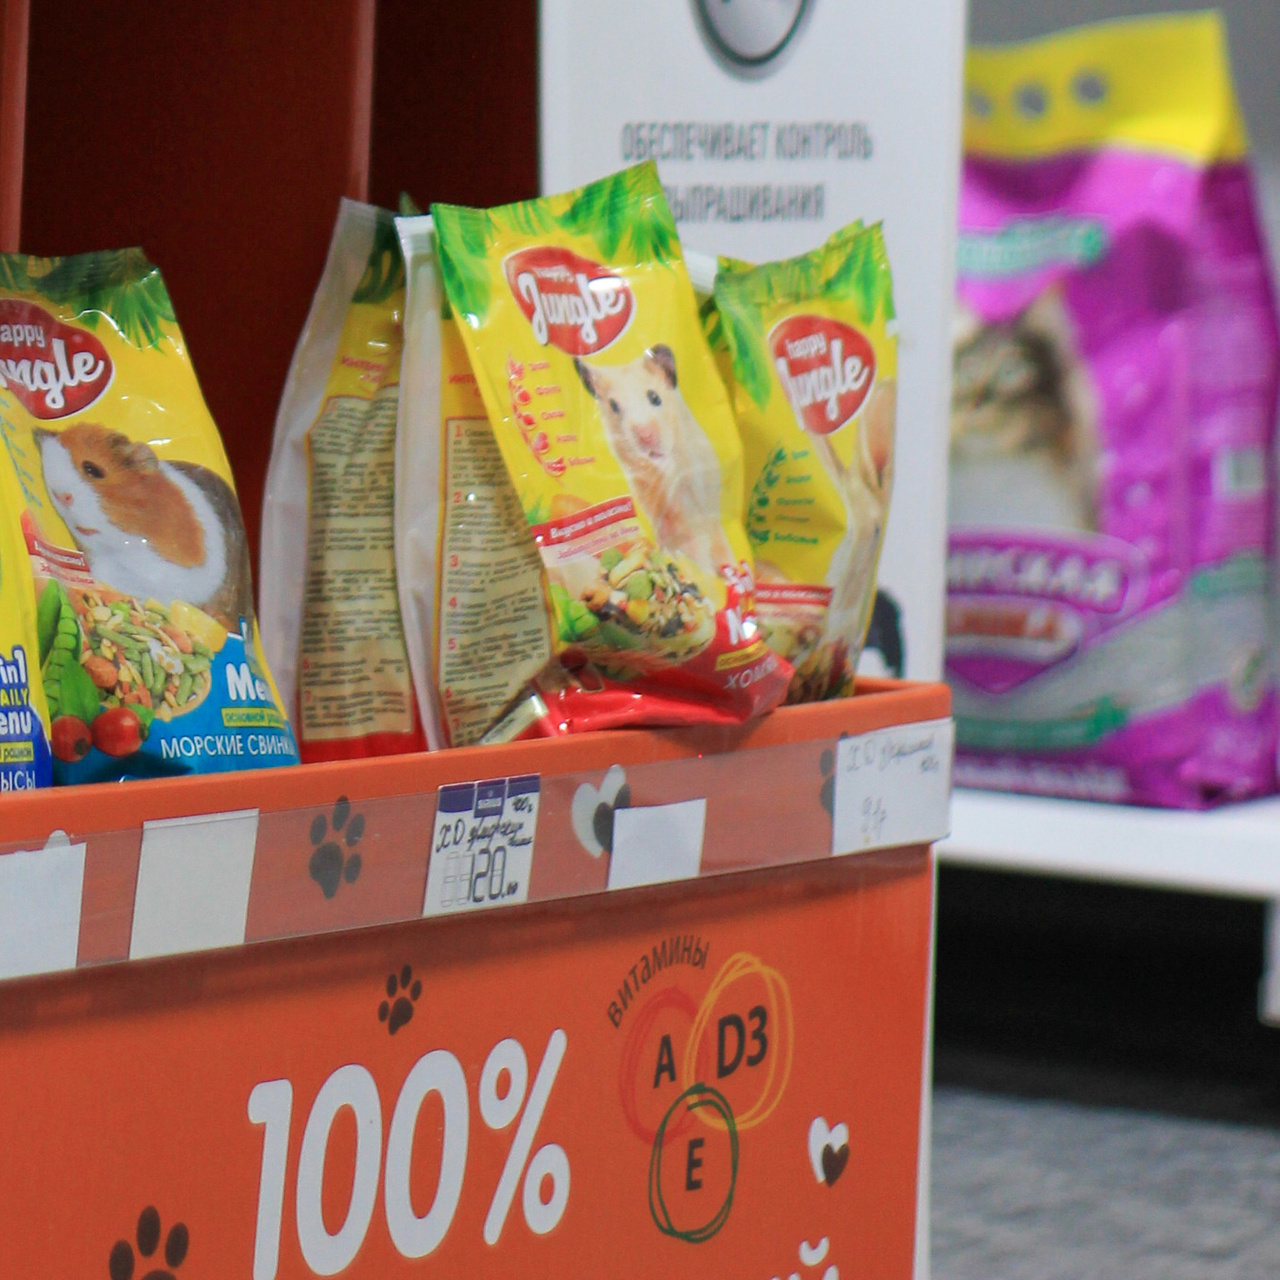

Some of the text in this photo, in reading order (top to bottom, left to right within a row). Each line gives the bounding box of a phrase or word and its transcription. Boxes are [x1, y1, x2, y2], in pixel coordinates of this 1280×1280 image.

[621, 121, 874, 162] ОБЕСПЕЧИВАЕТ КОНТРОЛЬ
[517, 269, 625, 346] Jungle
[784, 331, 827, 360] happy
[775, 338, 870, 431] Jungle
[3, 745, 34, 763] рацион
[160, 734, 244, 760] МОРСКИЕ
[652, 1033, 677, 1089] A
[717, 1004, 769, 1080] D3
[247, 1027, 571, 1280] 100%
[685, 1136, 705, 1192] E
